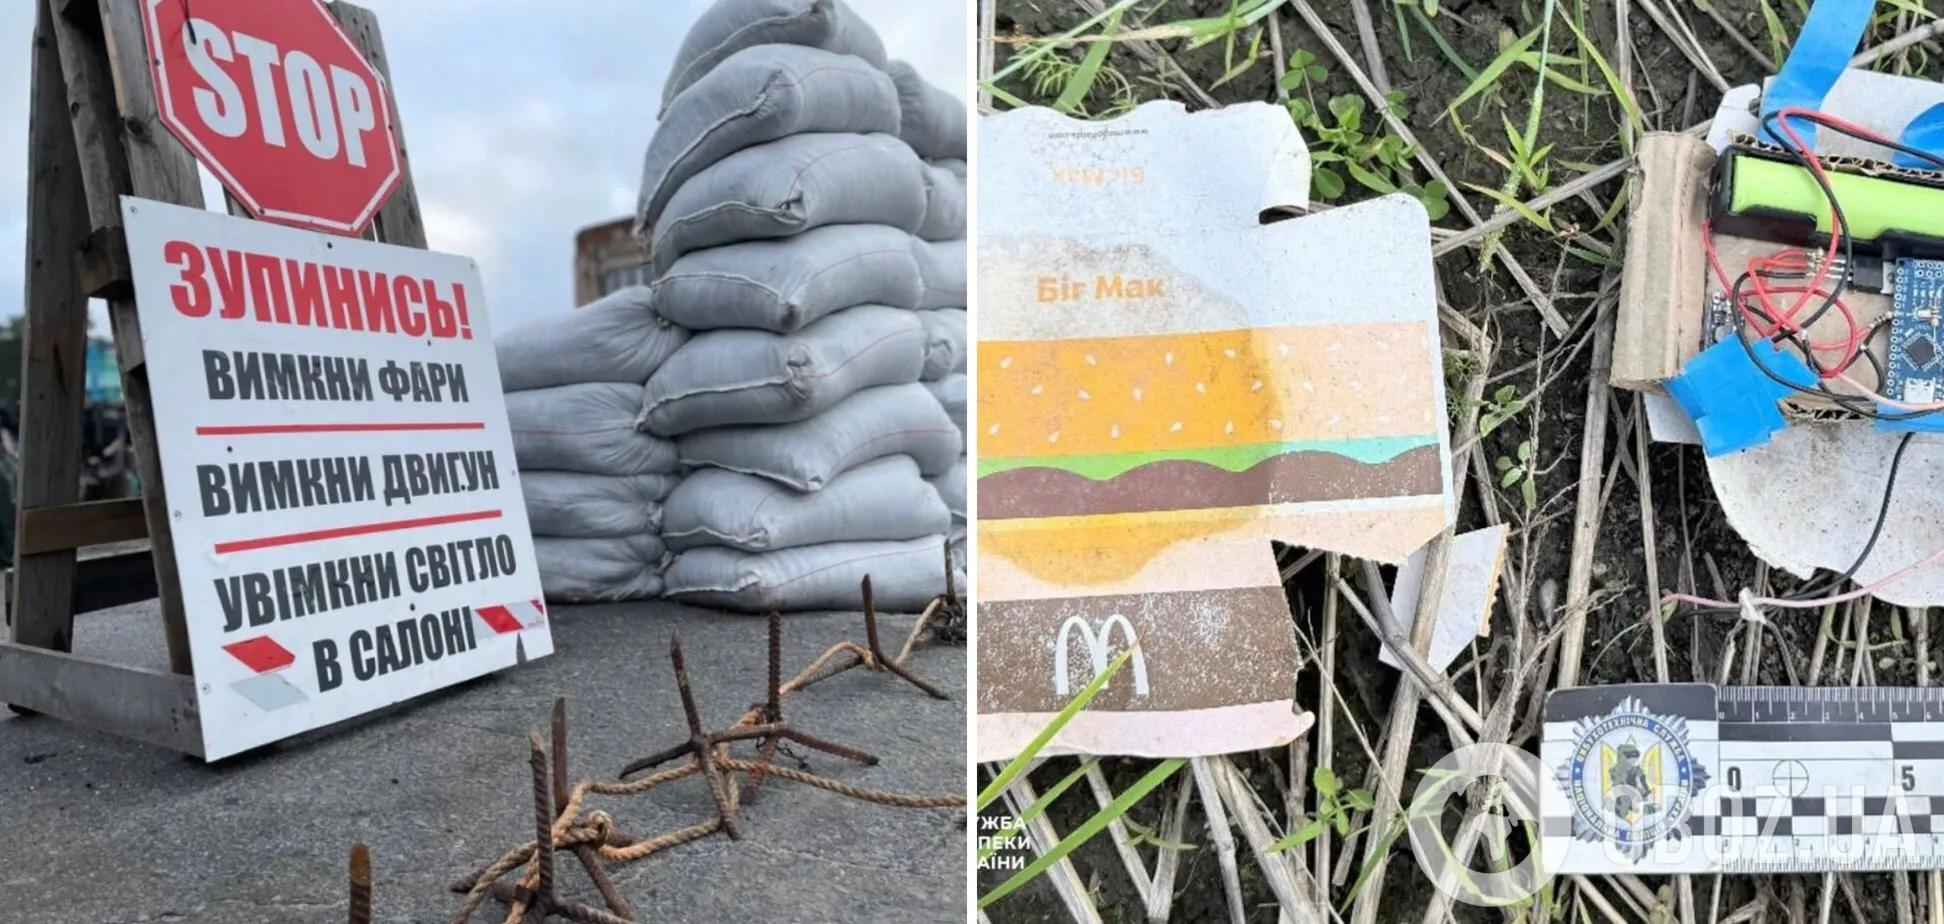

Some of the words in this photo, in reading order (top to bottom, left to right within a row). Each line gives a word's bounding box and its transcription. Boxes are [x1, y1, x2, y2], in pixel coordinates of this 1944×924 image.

[182, 18, 376, 168] STOP
[163, 240, 473, 340] ЗУПИНИСЬ!
[1037, 273, 1087, 302] Біг
[1095, 275, 1166, 300] Мак
[202, 350, 374, 401] ВИМКНИ
[378, 360, 469, 402] ФАРИ
[196, 455, 375, 517] ВИМКНИ
[382, 450, 500, 506] ДВИГУН
[213, 551, 401, 633] УВІМКНИ
[405, 534, 516, 593] СВІТЛО
[312, 638, 343, 693] В
[350, 605, 477, 681] САЛОНІ
[1727, 766, 1742, 792] 0
[1901, 765, 1915, 792] 5
